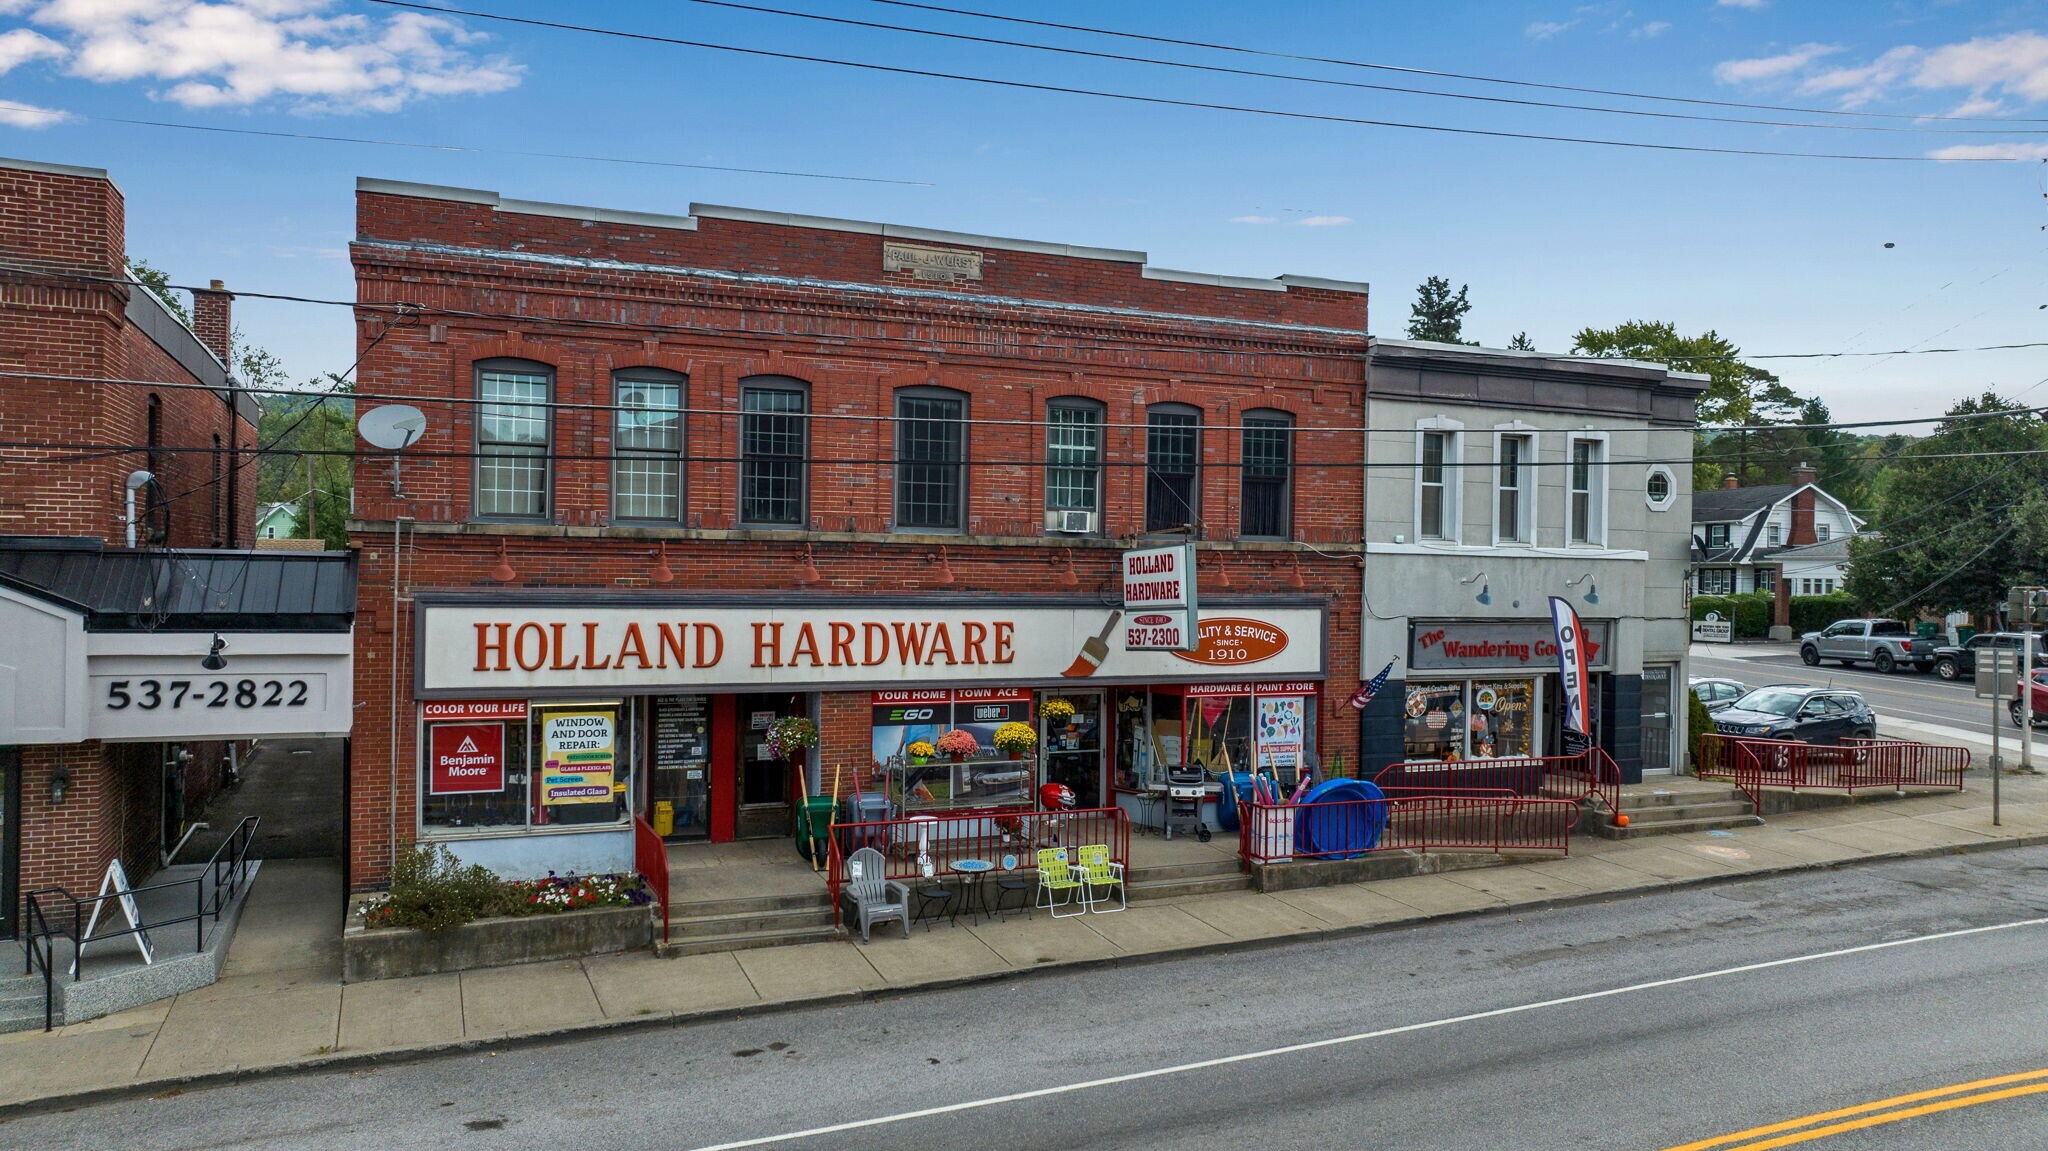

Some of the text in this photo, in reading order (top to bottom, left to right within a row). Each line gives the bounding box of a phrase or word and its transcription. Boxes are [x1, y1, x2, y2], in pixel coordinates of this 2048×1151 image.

[1128, 553, 1174, 575] HOLLAND
[1125, 580, 1180, 601] HARDWARE
[1128, 628, 1180, 646] 537-2300
[1224, 625, 1233, 636] &
[1234, 625, 1278, 644] SERVICE
[473, 621, 1016, 672] HOLLAND HARDWARE
[1418, 628, 1446, 650] The
[1443, 640, 1530, 662] Wandering
[1208, 649, 1247, 660] 1910
[878, 688, 1018, 700] YOUR HOME TOWN ACE
[1190, 684, 1242, 693] HARDWARE
[1256, 683, 1284, 691] PAINT
[107, 679, 309, 710] 537-2822
[425, 703, 525, 714] COLOR YOUR LIFE
[1495, 696, 1522, 714] Open
[889, 709, 933, 721] EGO
[555, 718, 605, 727] WINDOW
[551, 729, 608, 739] AND DOOR
[559, 740, 600, 750] REPAIR:
[440, 754, 495, 767] Benjamin
[448, 767, 487, 776] Moore
[560, 775, 583, 783] Screen
[551, 786, 607, 797] Insulated Glass
